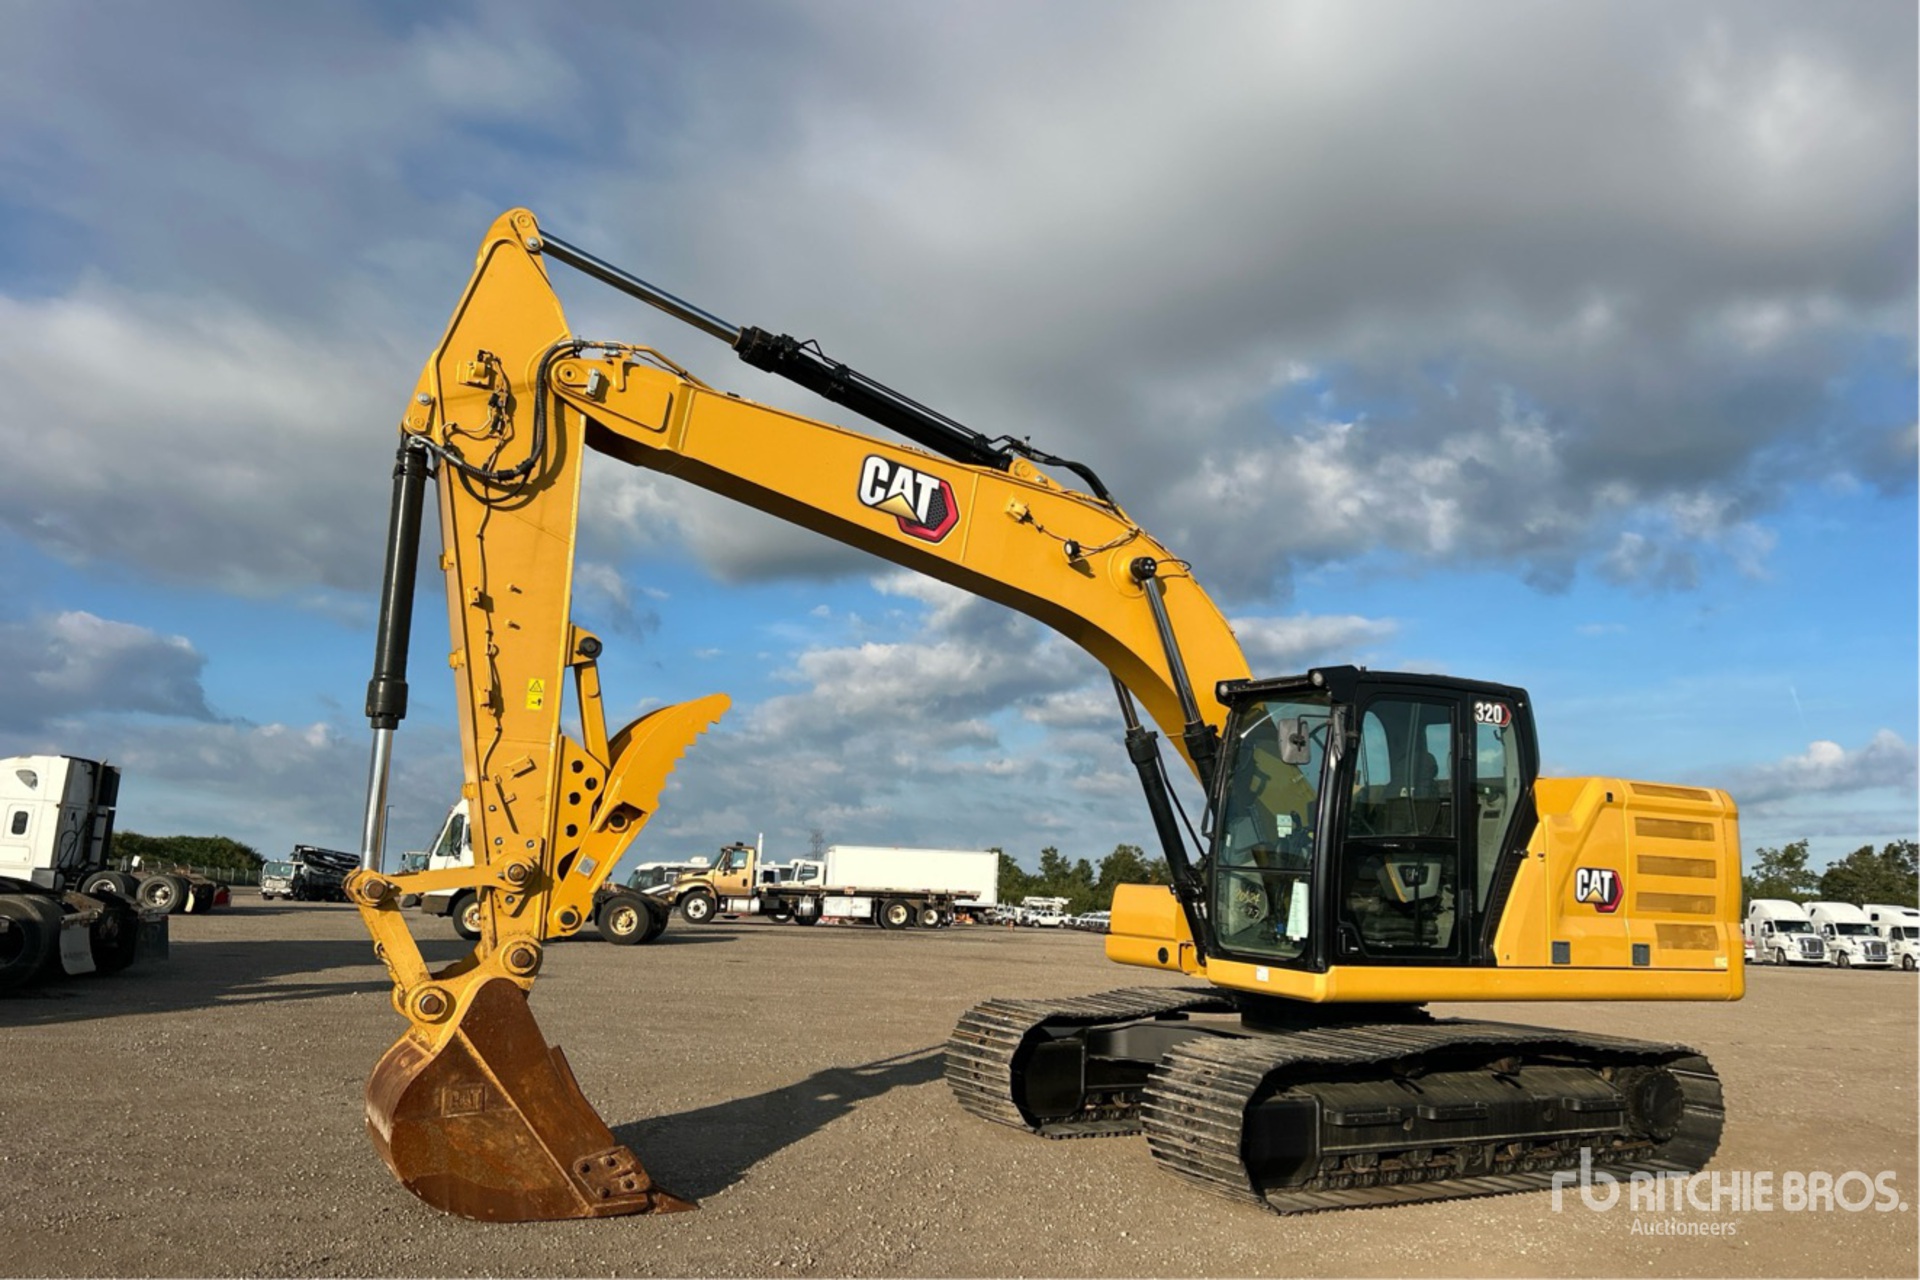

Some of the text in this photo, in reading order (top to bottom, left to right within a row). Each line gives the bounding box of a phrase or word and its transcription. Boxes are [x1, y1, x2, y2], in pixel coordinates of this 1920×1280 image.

[860, 456, 940, 524] CAT
[1475, 702, 1502, 723] 320
[1577, 868, 1613, 903] CAT
